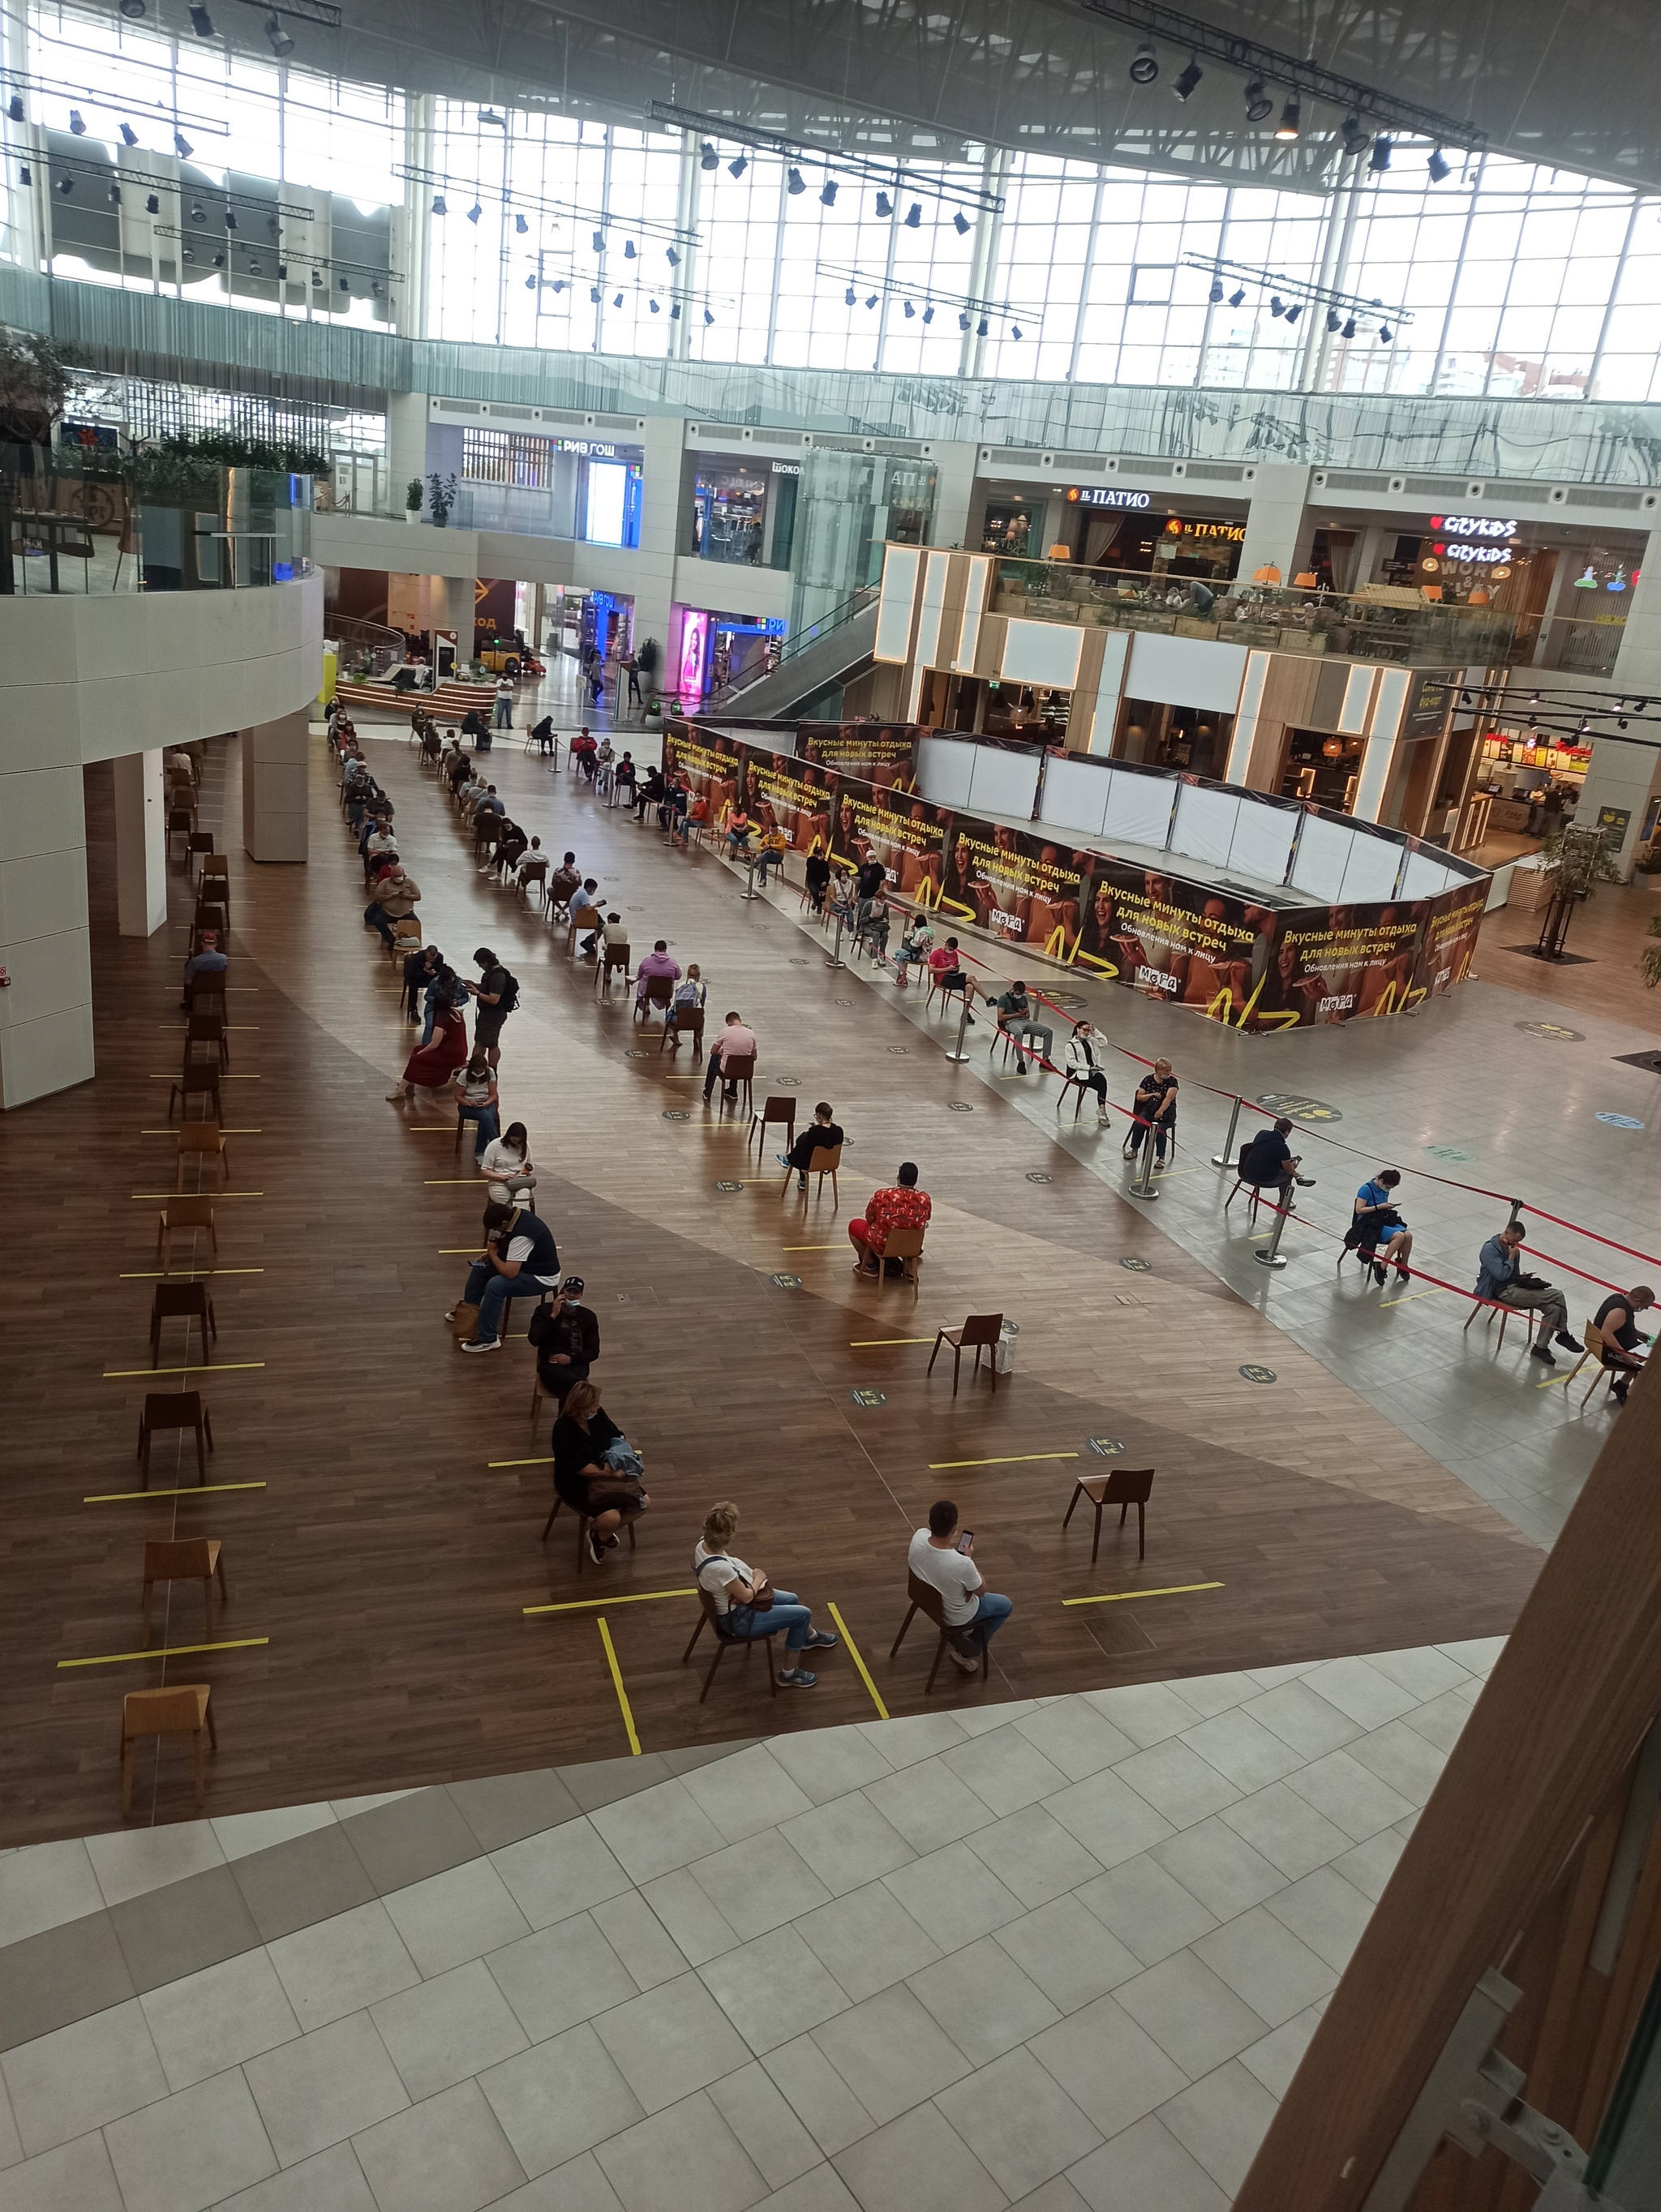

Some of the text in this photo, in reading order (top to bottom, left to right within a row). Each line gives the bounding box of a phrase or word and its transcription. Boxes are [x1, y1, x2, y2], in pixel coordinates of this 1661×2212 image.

[564, 440, 615, 457] РИВ ГОШ
[1092, 489, 1150, 508] ПАТИО
[1440, 560, 1492, 578] WOR
[1463, 577, 1472, 588] &
[1455, 581, 1501, 600] LAY
[667, 733, 739, 766] Вкусные минуты отдыха
[808, 737, 912, 749] Вкусные минуты отдыха
[868, 751, 896, 760] встреч
[676, 751, 727, 774] для новых встреч
[749, 761, 830, 799] Вкусные минуты отдыха
[758, 780, 818, 808] для новых встреч
[843, 794, 944, 837] Вкусные минуты отдыха
[855, 814, 927, 846] для новых встреч
[858, 828, 891, 846] Обновления
[891, 840, 901, 851] нам
[906, 847, 920, 858] лицу
[959, 832, 1081, 884] Вкусные минуты отдыха
[972, 855, 1060, 893] для новых встреч
[976, 870, 1015, 890] Обновления
[1015, 884, 1028, 895] нам
[1034, 892, 1052, 905] лицу
[1100, 881, 1255, 943] Вкусные минуты отдыха
[1116, 907, 1227, 952] для новых встреч
[1121, 922, 1170, 946] Обновления
[1170, 940, 1187, 954] нам
[1194, 950, 1217, 965] лицу
[1284, 923, 1418, 945] Вкусные минуты отдыха
[1299, 941, 1397, 962] для новых встреч
[1304, 963, 1349, 973] Обновления
[1369, 958, 1387, 967] лицу
